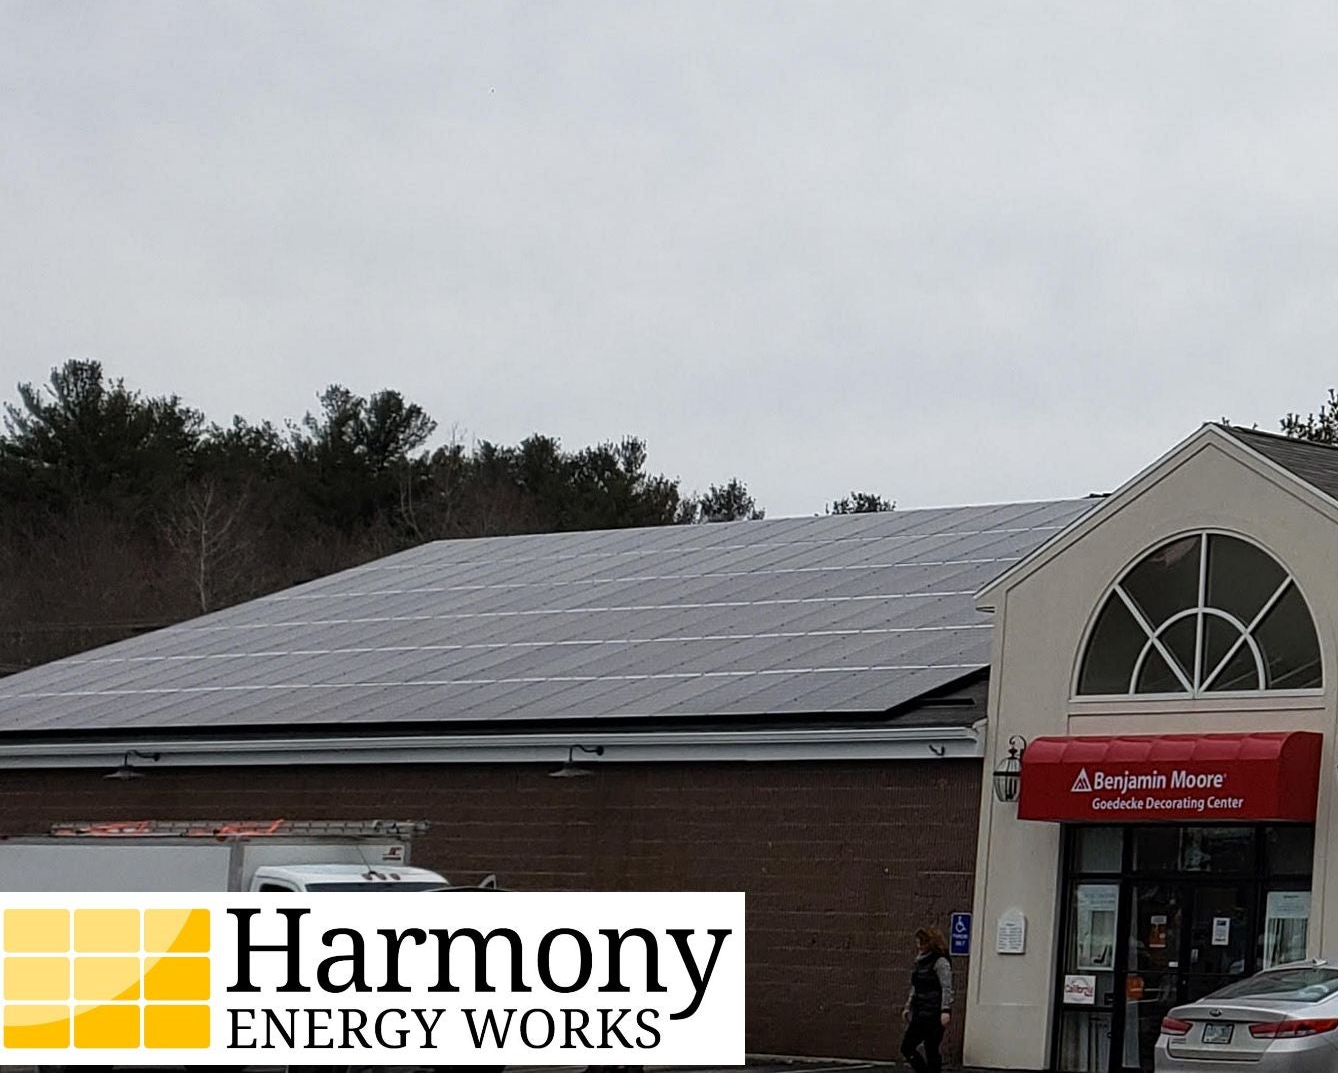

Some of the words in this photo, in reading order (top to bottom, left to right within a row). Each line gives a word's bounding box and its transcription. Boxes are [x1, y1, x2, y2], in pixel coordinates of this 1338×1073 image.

[1093, 770, 1167, 794] Benjamin
[1091, 797, 1144, 810] Goedecke
[1145, 796, 1204, 811] Decorating
[1206, 796, 1244, 808] Center
